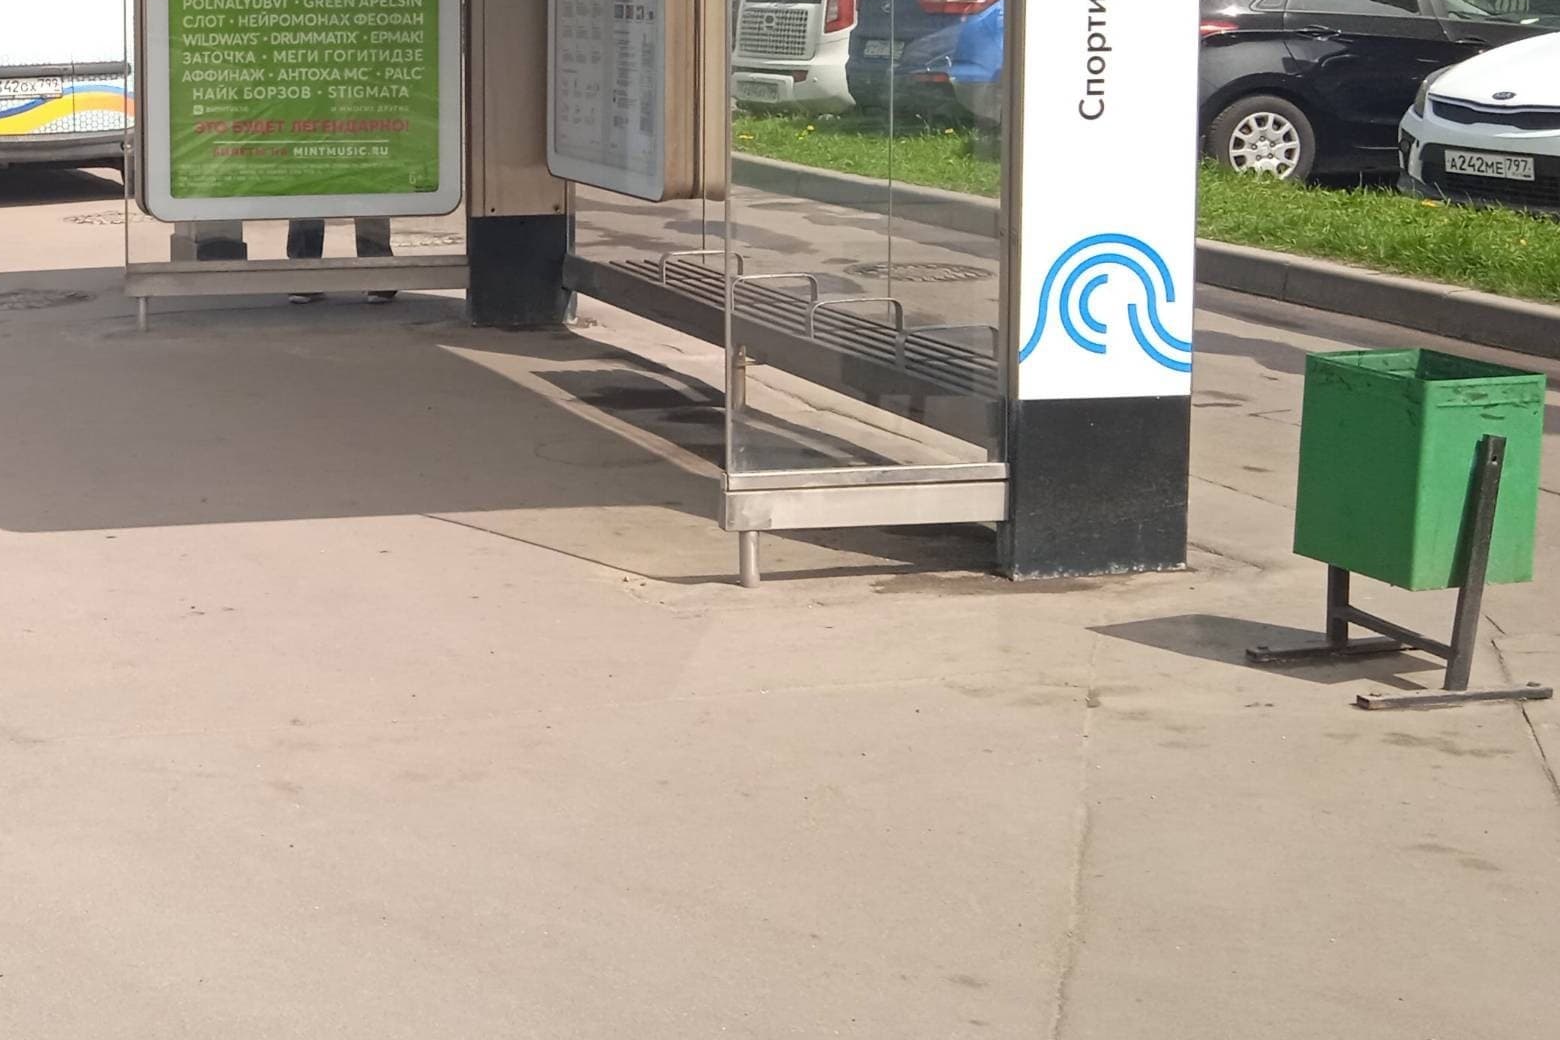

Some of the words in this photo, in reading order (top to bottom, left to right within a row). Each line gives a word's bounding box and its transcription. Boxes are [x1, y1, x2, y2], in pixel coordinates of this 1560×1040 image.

[183, 14, 226, 28] СЛОТ
[238, 11, 351, 27] НЕЙРОМОНАХ
[354, 12, 424, 25] ФЕОФАН
[370, 30, 424, 43] ЕРМАК!
[182, 51, 256, 64] ЗАТОЧКА
[273, 49, 318, 62] МЕГИ
[324, 48, 424, 63] ГОГИТИДЗЕ
[182, 68, 265, 82] АФФИНАЖ
[279, 67, 342, 80] АНТОХА
[192, 84, 238, 100] НАЙК
[243, 87, 311, 99] БОРЗОВ
[194, 120, 228, 134] ЭТО
[231, 119, 286, 135] БУДЕТ
[290, 119, 409, 134] ЛЕГЕНДАРНО!
[293, 146, 389, 157] MINTMUSIC.RU
[1450, 155, 1505, 175] А242МЕ
[1506, 158, 1529, 172] 797
